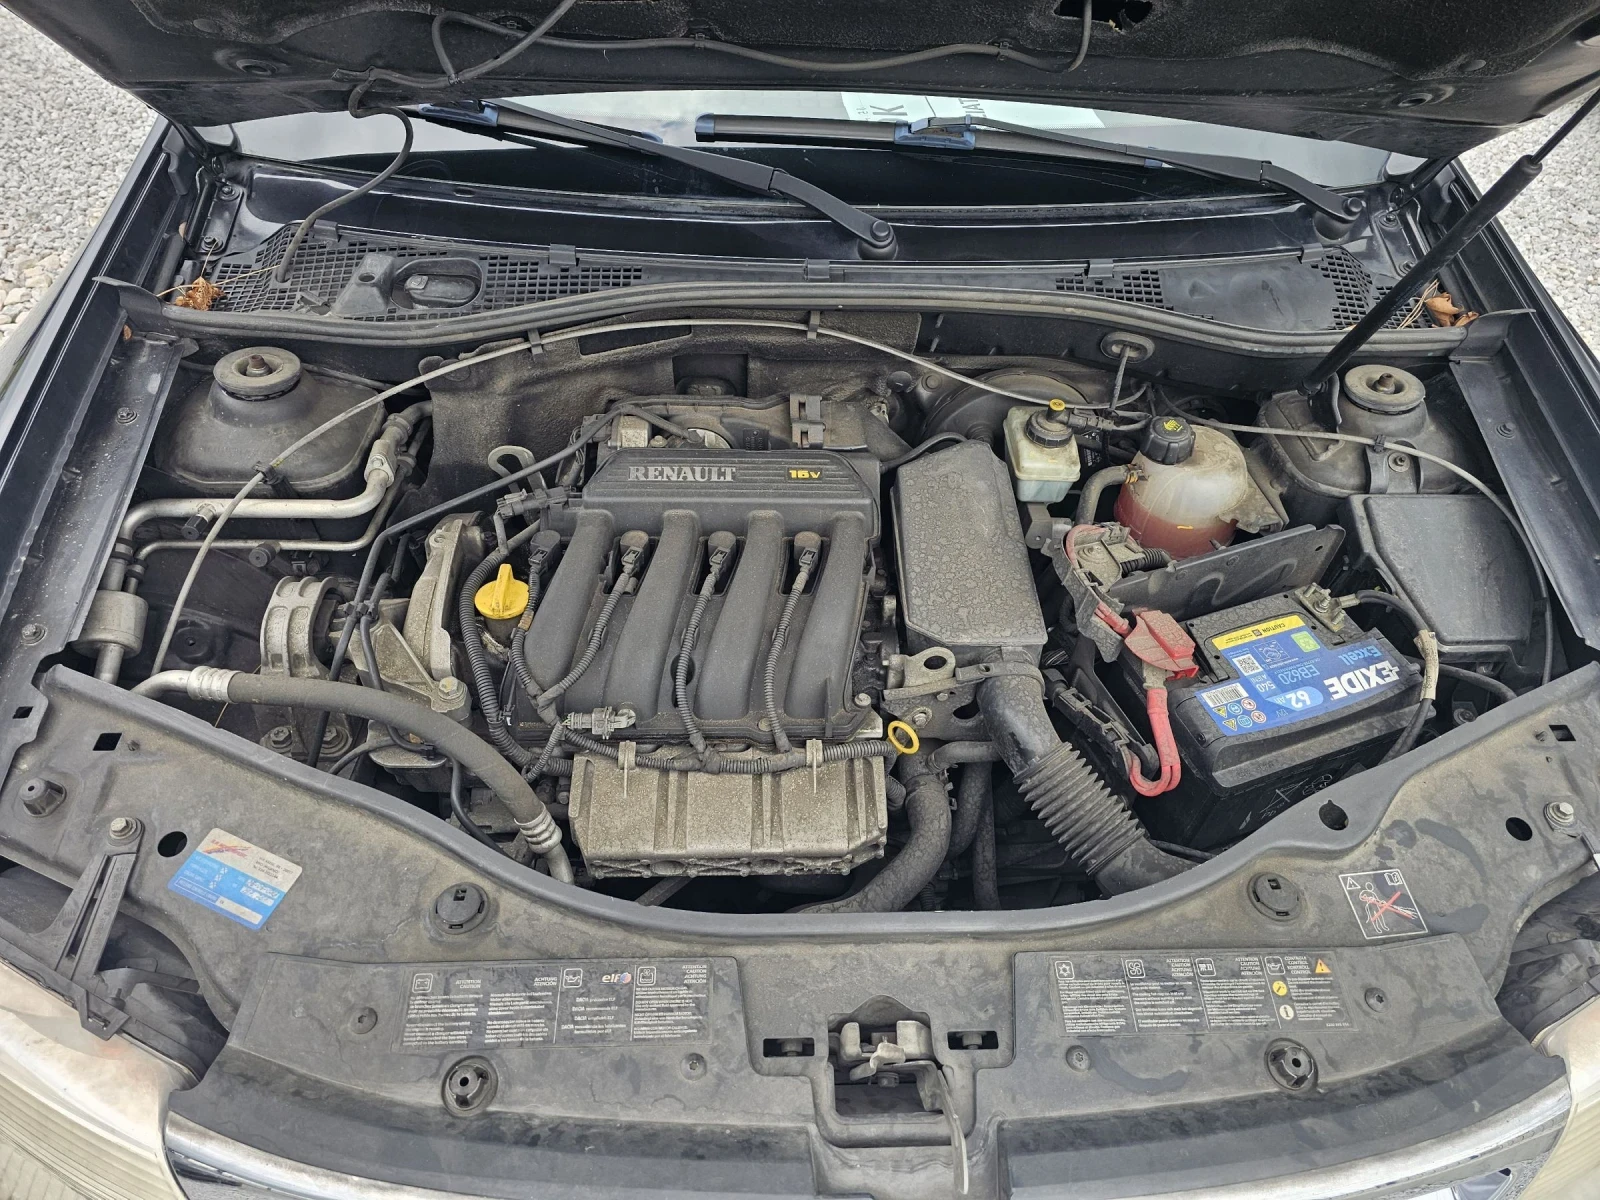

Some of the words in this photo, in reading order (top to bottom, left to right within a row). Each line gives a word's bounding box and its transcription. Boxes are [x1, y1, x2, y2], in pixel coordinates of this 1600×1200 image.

[628, 466, 736, 482] RENAULT
[1262, 623, 1286, 633] CAUTION
[1339, 644, 1384, 666] Excell
[1278, 664, 1320, 685] EB620
[1323, 660, 1400, 701] EXIDE
[1256, 680, 1276, 693] 540
[1290, 690, 1312, 710] 62
[1276, 708, 1289, 718] 12V
